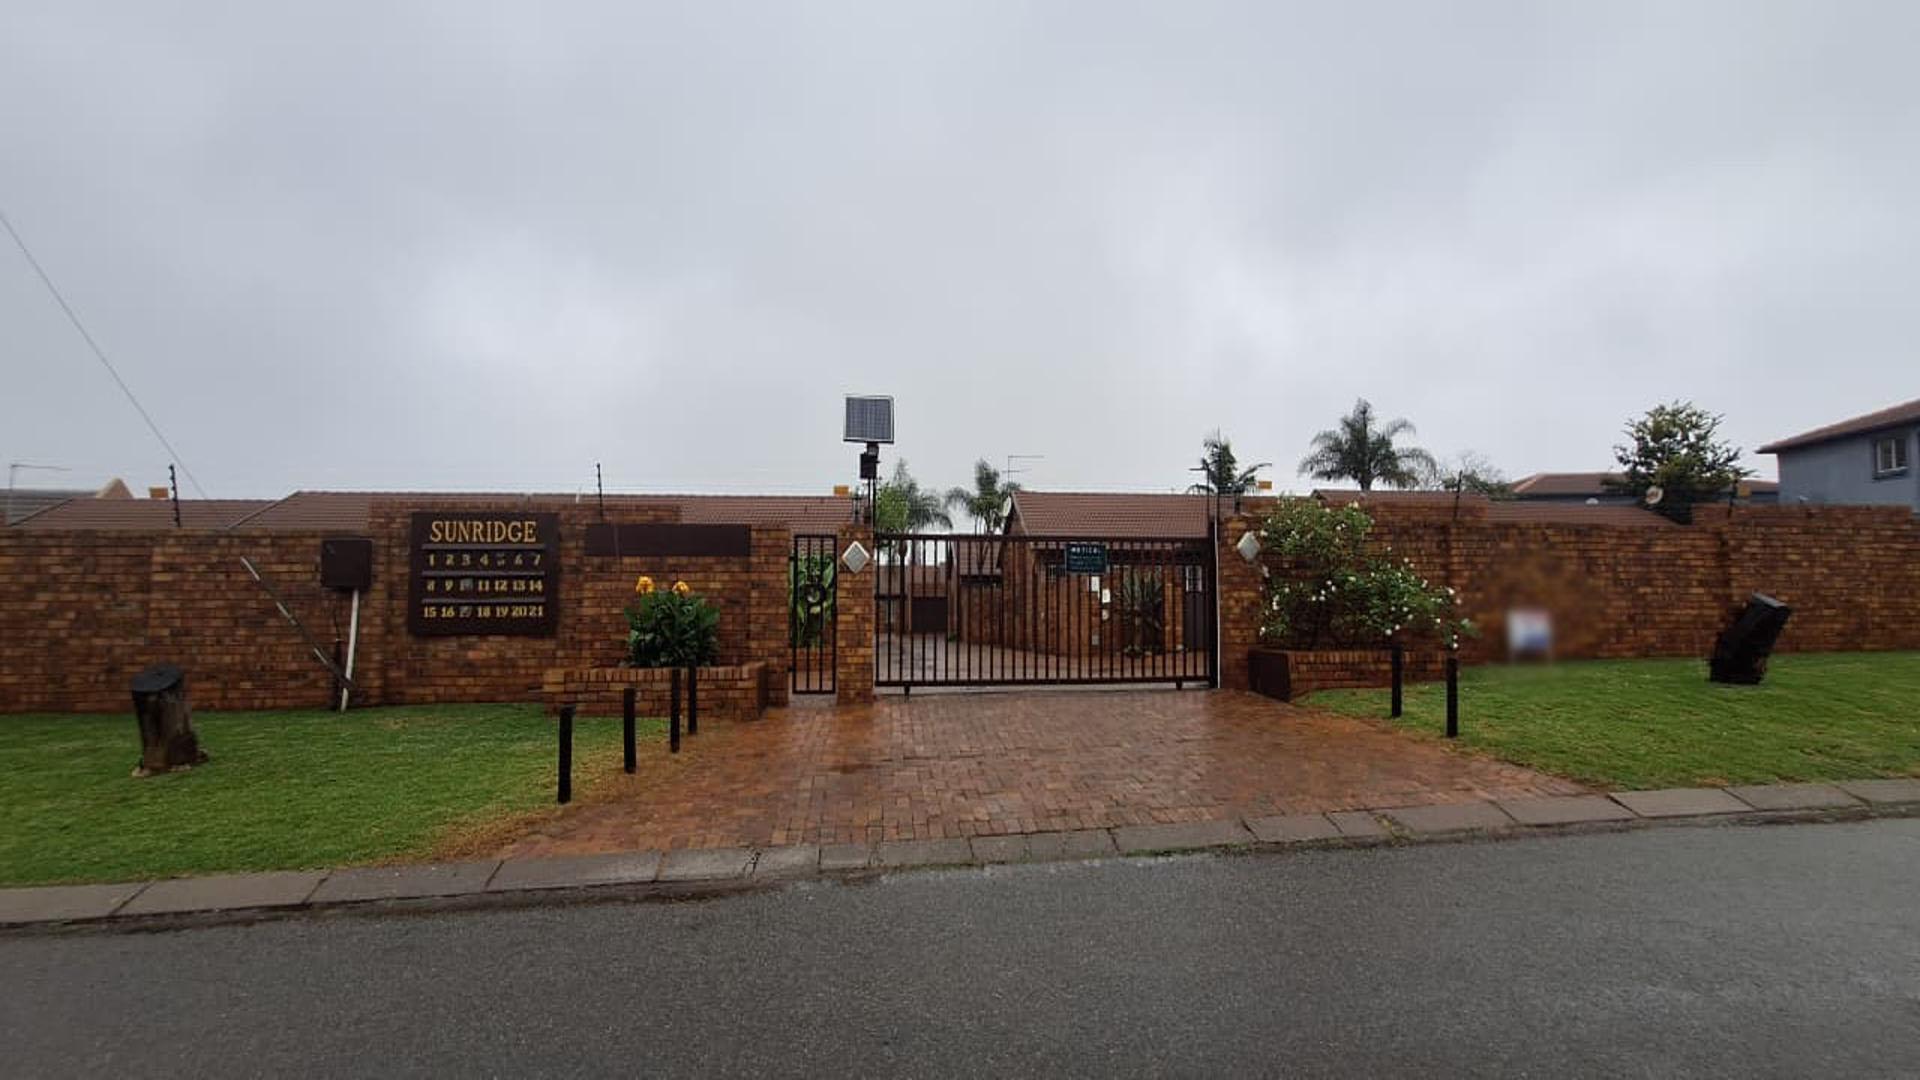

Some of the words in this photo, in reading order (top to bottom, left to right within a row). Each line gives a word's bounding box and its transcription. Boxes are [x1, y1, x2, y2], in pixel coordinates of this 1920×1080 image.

[430, 521, 537, 542] SUNRIDGE
[429, 553, 435, 567] 1
[445, 553, 454, 566] 2
[462, 553, 471, 566] 3
[480, 553, 489, 566] 4
[531, 553, 541, 566] 7
[445, 579, 454, 592] 9
[478, 579, 490, 592] 11
[494, 579, 508, 592] 12
[512, 579, 526, 592] 13
[529, 579, 543, 592] 14
[423, 606, 437, 618] 15
[441, 606, 455, 618] 16
[477, 606, 491, 618] 18
[495, 606, 509, 618] 19
[511, 605, 527, 618] 20
[528, 605, 543, 618] 21
